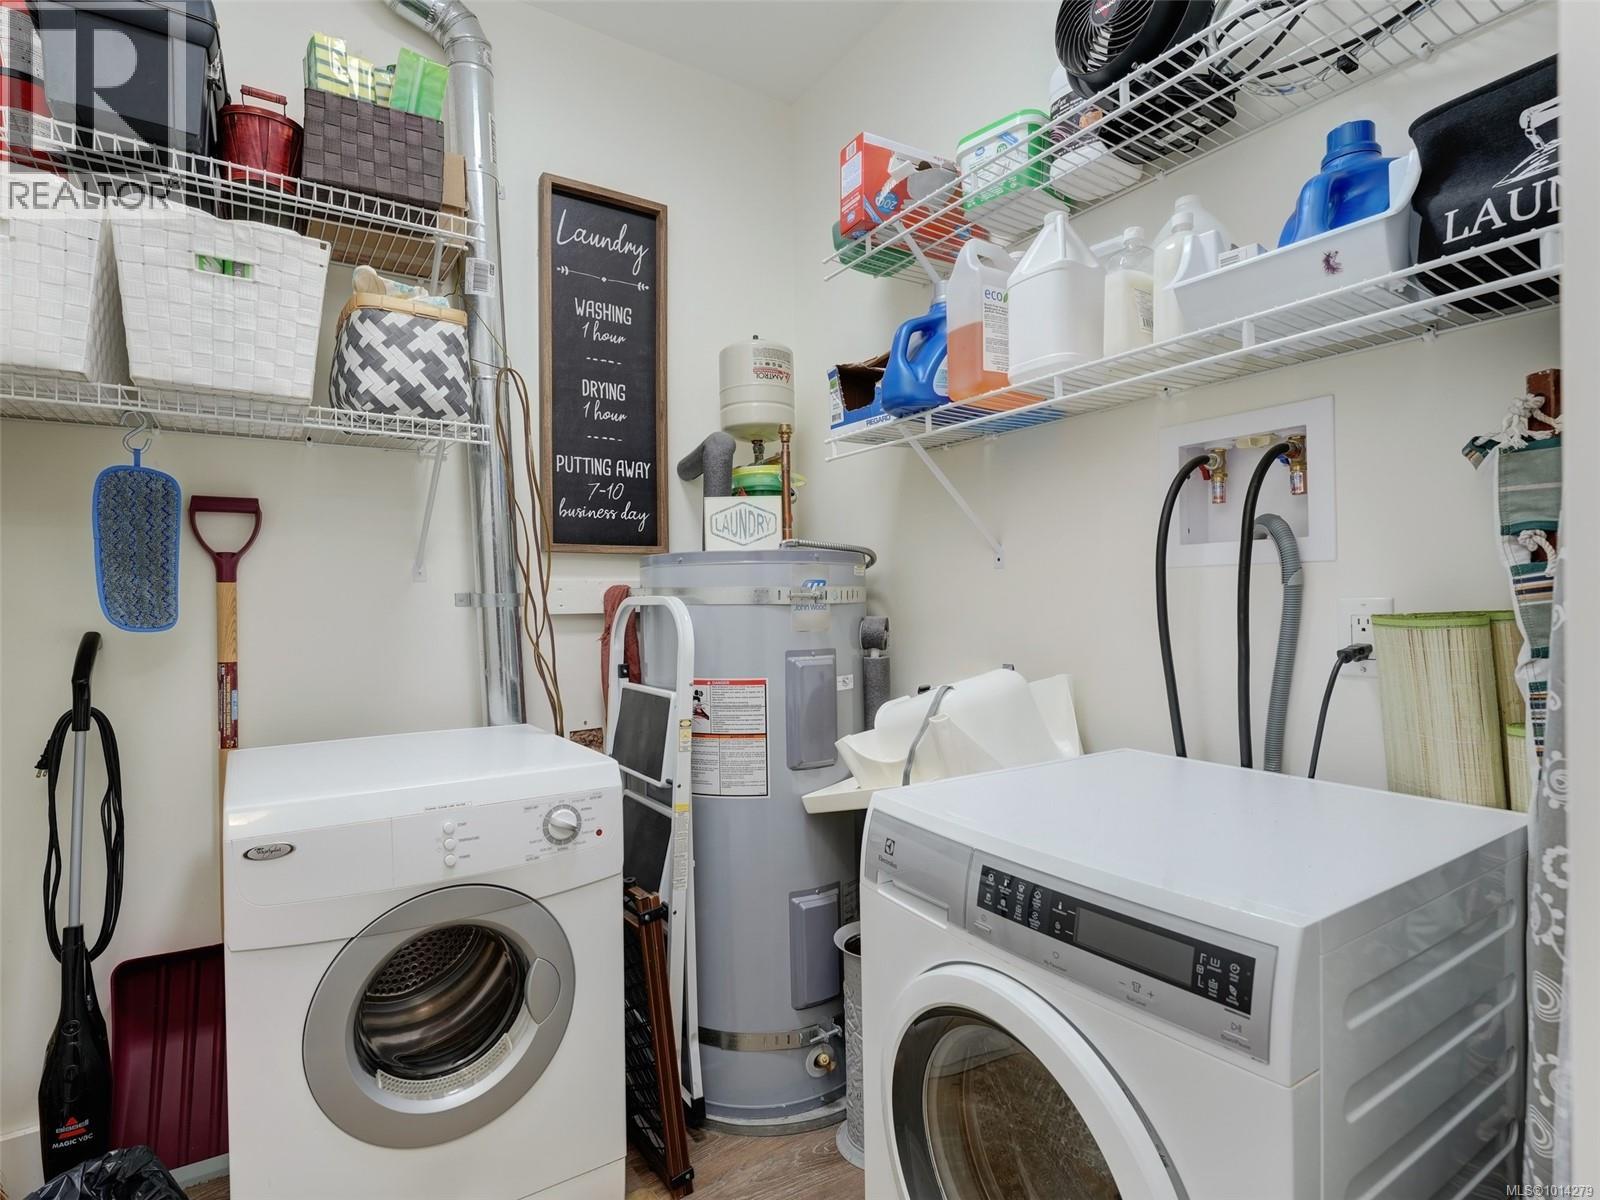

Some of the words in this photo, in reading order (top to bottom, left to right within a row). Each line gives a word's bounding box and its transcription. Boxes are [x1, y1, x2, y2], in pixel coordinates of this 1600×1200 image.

[1443, 175, 1559, 244] LAU
[556, 208, 649, 276] Laundry
[984, 288, 1003, 302] eco
[574, 297, 632, 325] WASHING
[582, 321, 590, 338] 1
[593, 320, 627, 344] hour
[581, 378, 626, 402] DRYING
[583, 401, 591, 418] 1
[594, 400, 627, 422] hour
[556, 454, 612, 477] PUTTING
[616, 459, 651, 479] AWAY
[587, 482, 625, 501] 7-10
[559, 497, 618, 520] business
[620, 501, 650, 532] day
[715, 508, 772, 540] LAUNDRY
[52, 1138, 77, 1150] MAGIC
